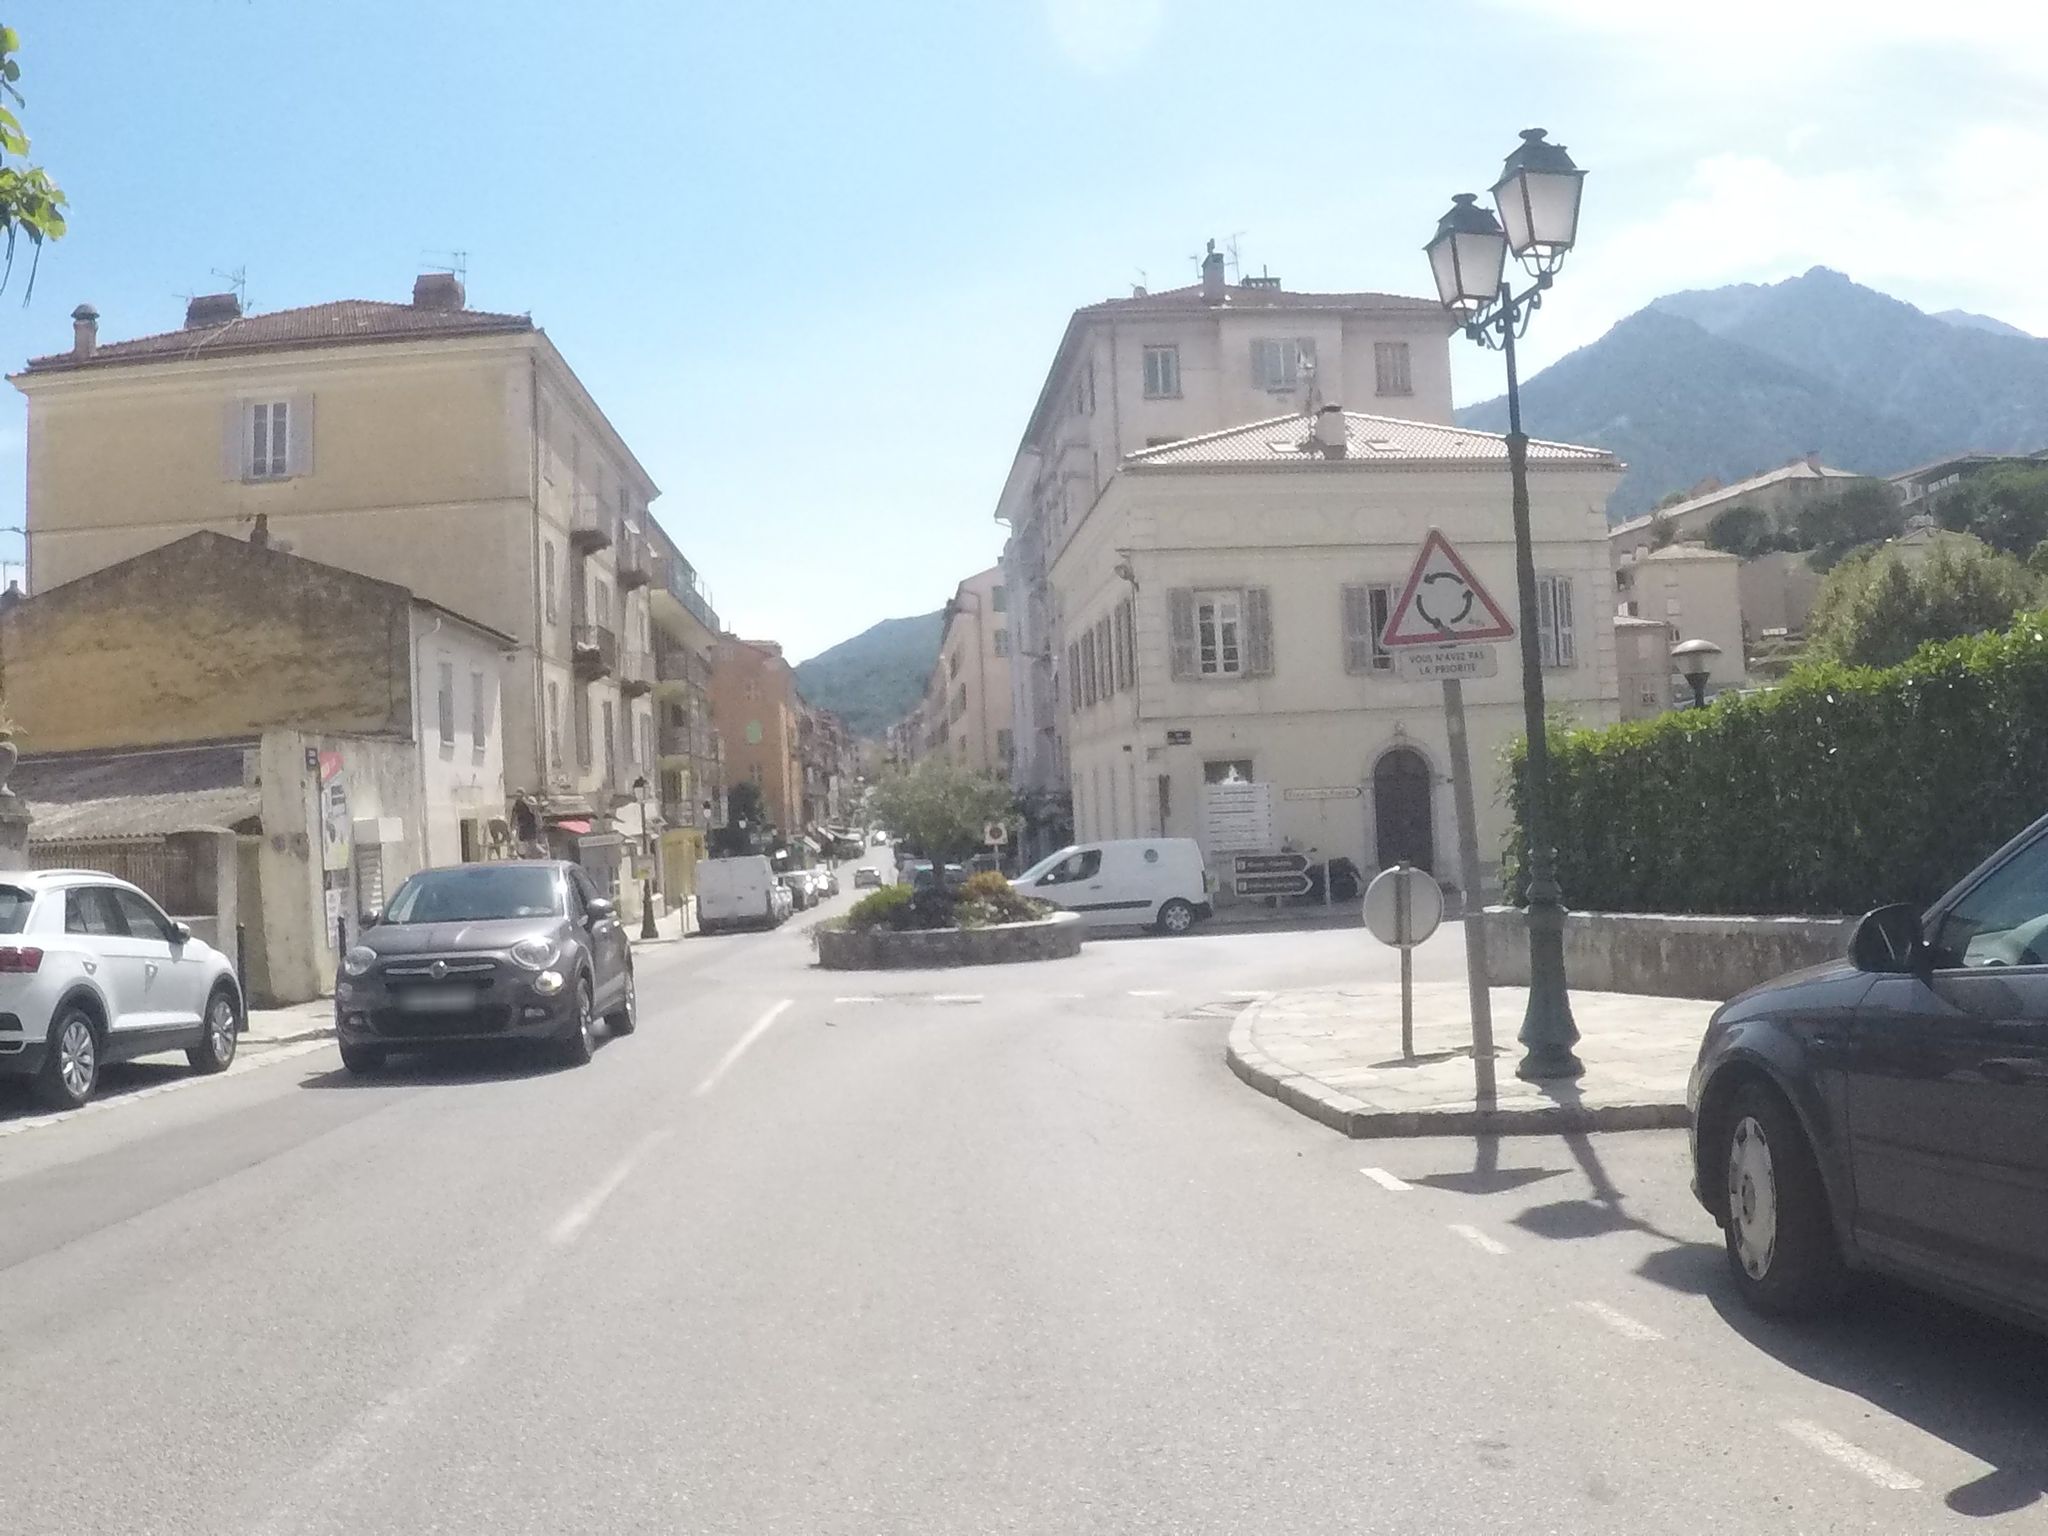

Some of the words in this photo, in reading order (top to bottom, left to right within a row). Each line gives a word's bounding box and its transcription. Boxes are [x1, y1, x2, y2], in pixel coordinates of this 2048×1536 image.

[1409, 654, 1433, 664] VOUS
[1435, 652, 1465, 662] N'AVEZ
[1467, 651, 1485, 660] PAS
[1419, 665, 1431, 675] LA
